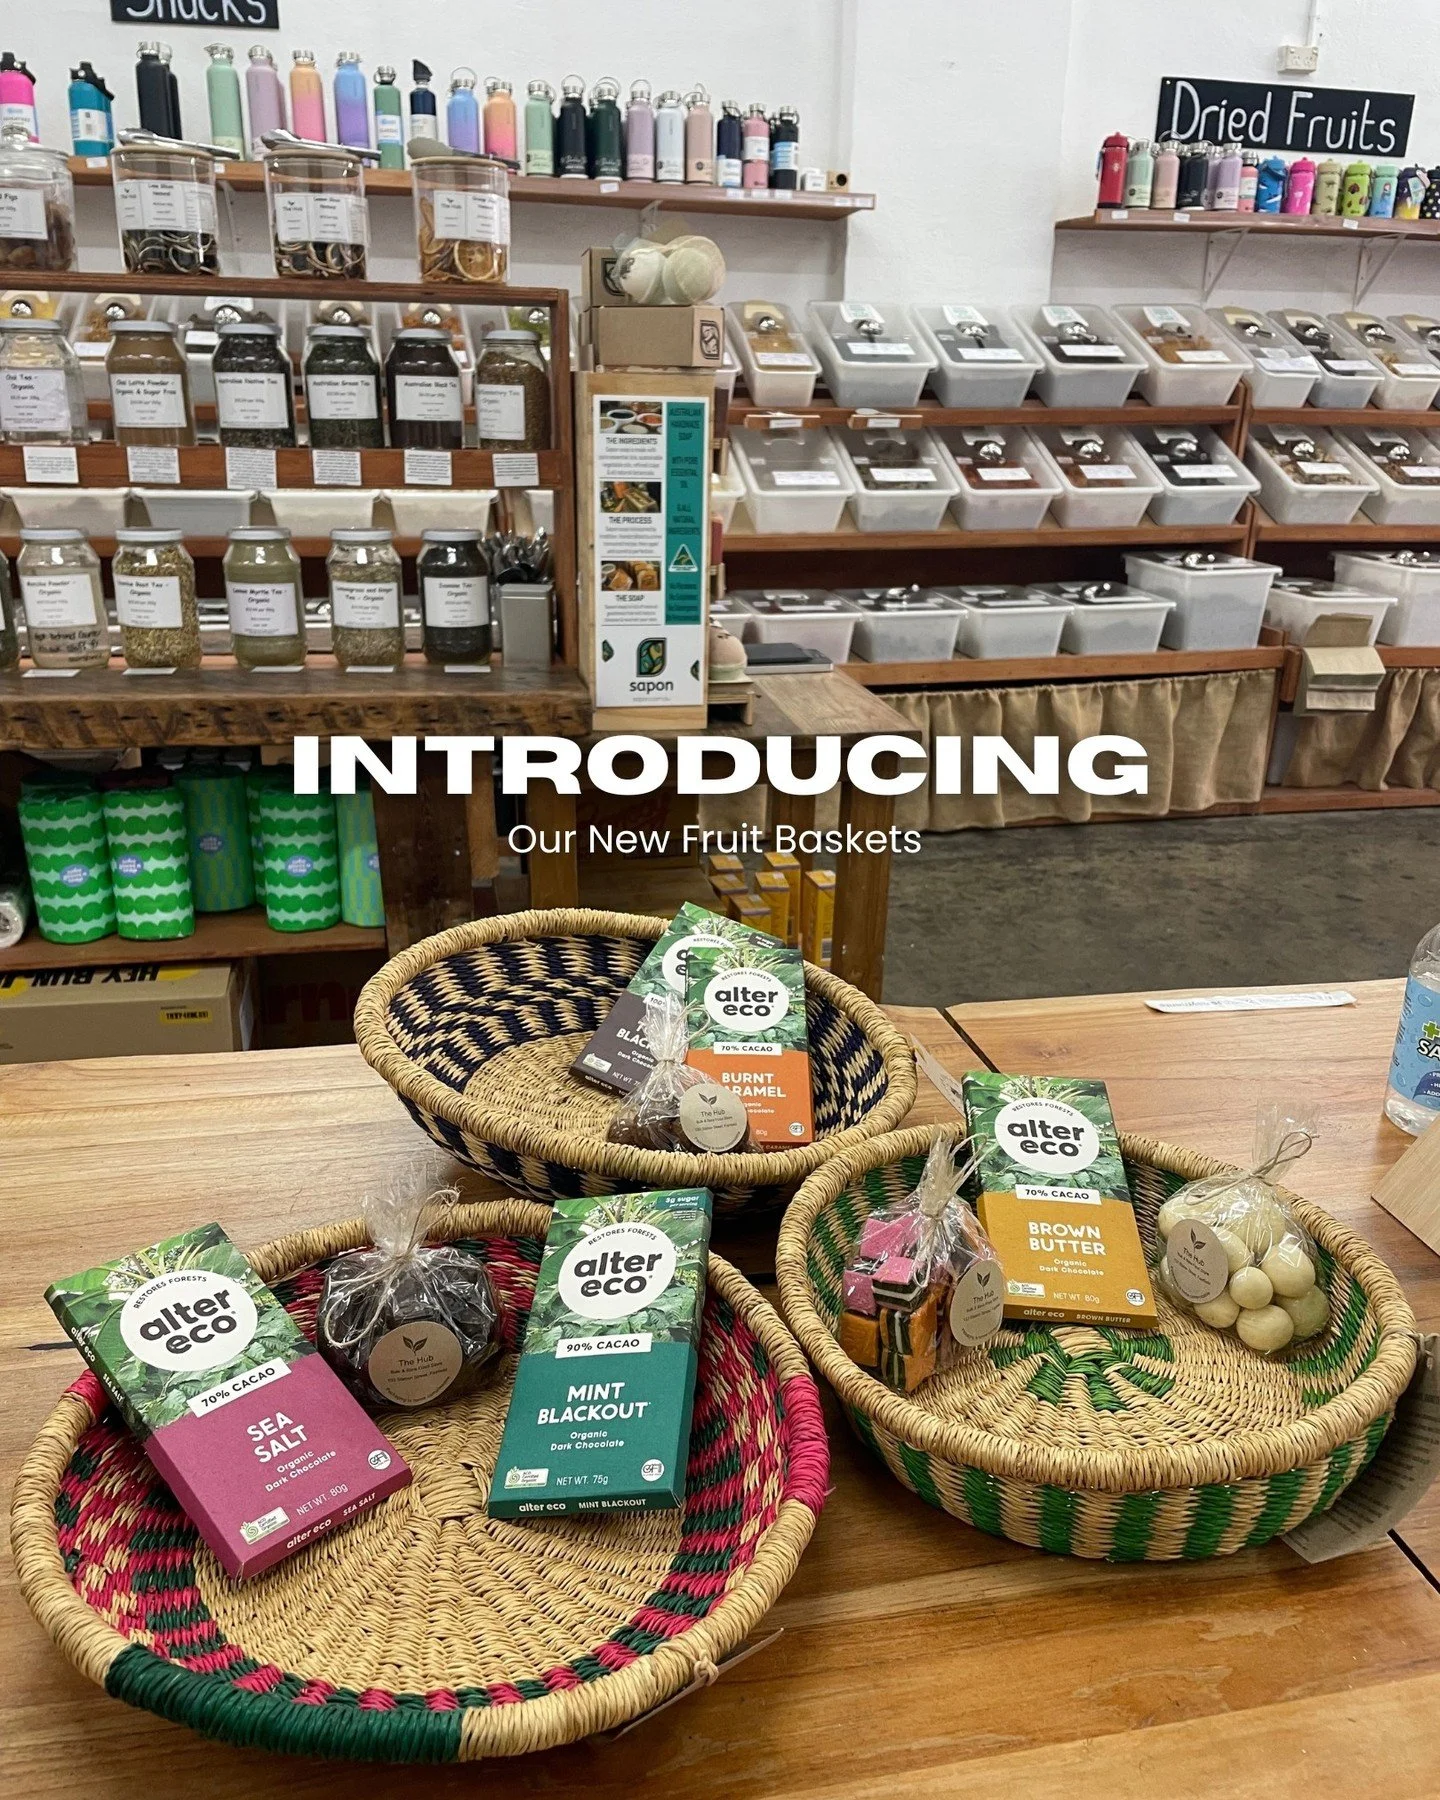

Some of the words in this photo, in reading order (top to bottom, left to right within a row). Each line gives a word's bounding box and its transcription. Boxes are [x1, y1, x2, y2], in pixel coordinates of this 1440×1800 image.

[1172, 81, 1272, 143] Dried
[1287, 90, 1397, 154] Fruits
[609, 516, 621, 524] THE
[622, 516, 652, 524] PROCESS
[616, 594, 627, 602] THE
[628, 594, 645, 602] SOAP
[629, 680, 674, 694] sapon
[721, 971, 748, 981] RESTORES
[749, 971, 772, 982] FORESTS
[714, 986, 779, 1003] alter
[722, 1004, 771, 1017] eco
[617, 1050, 631, 1060] Dark
[722, 1072, 774, 1084] BURNT
[724, 1085, 786, 1098] RAMEL
[744, 1102, 762, 1110] ganic
[1012, 1102, 1043, 1113] RESTORES
[1045, 1102, 1074, 1117] FORESTS
[1007, 1120, 1085, 1141] alter
[1020, 1138, 1080, 1157] eco
[1025, 1188, 1049, 1197] 70%
[1051, 1190, 1090, 1200] CACAO
[588, 1228, 626, 1246] RESTORES
[627, 1227, 657, 1240] FORESTS
[1028, 1222, 1101, 1239] BROWN
[1029, 1237, 1106, 1256] BUTTER
[573, 1251, 663, 1278] alter
[1039, 1264, 1059, 1273] Dark
[1060, 1266, 1104, 1276] Chocolate
[1053, 1258, 1087, 1268] Organic
[133, 1282, 167, 1309] RESTORES
[168, 1275, 208, 1284] FORESTS
[580, 1276, 648, 1298] eco
[973, 1294, 983, 1304] The
[983, 1290, 995, 1300] Hub
[1053, 1292, 1067, 1301] NET
[1084, 1294, 1100, 1304] 80g
[139, 1287, 231, 1341] alter
[1024, 1308, 1046, 1317] alter
[1048, 1311, 1065, 1319] eco
[1076, 1314, 1104, 1322] BROWN
[1105, 1315, 1131, 1323] BUTTER
[165, 1316, 237, 1355] eco
[71, 1326, 86, 1346] alter
[83, 1344, 96, 1362] eco
[566, 1342, 593, 1353] 90%
[596, 1338, 640, 1350] CACAO
[398, 1359, 415, 1367] The
[417, 1354, 434, 1363] Hub
[102, 1373, 114, 1388] SEA
[112, 1384, 124, 1402] SALT
[201, 1389, 230, 1407] 70%
[232, 1367, 276, 1393] CACAO
[566, 1382, 626, 1402] MINT
[537, 1402, 649, 1425] BLACKOUT
[246, 1412, 294, 1442] SEA
[570, 1430, 608, 1440] Organic
[254, 1425, 309, 1464] SALT
[550, 1442, 572, 1451] Dark
[575, 1439, 625, 1449] Chocolate
[276, 1450, 314, 1474] Organic
[265, 1475, 288, 1492] Dark
[289, 1450, 337, 1480] Chocolate
[556, 1477, 572, 1486] NET
[592, 1474, 609, 1485] 75g
[296, 1502, 314, 1517] NET
[330, 1482, 349, 1499] 80g
[342, 1505, 358, 1516] SEA
[358, 1492, 376, 1510] SALT
[518, 1502, 544, 1512] alter
[546, 1502, 566, 1511] eco
[578, 1501, 600, 1509] MINT
[601, 1498, 646, 1508] BLACKOUT
[286, 1528, 311, 1550] alter
[312, 1518, 332, 1534] eco
